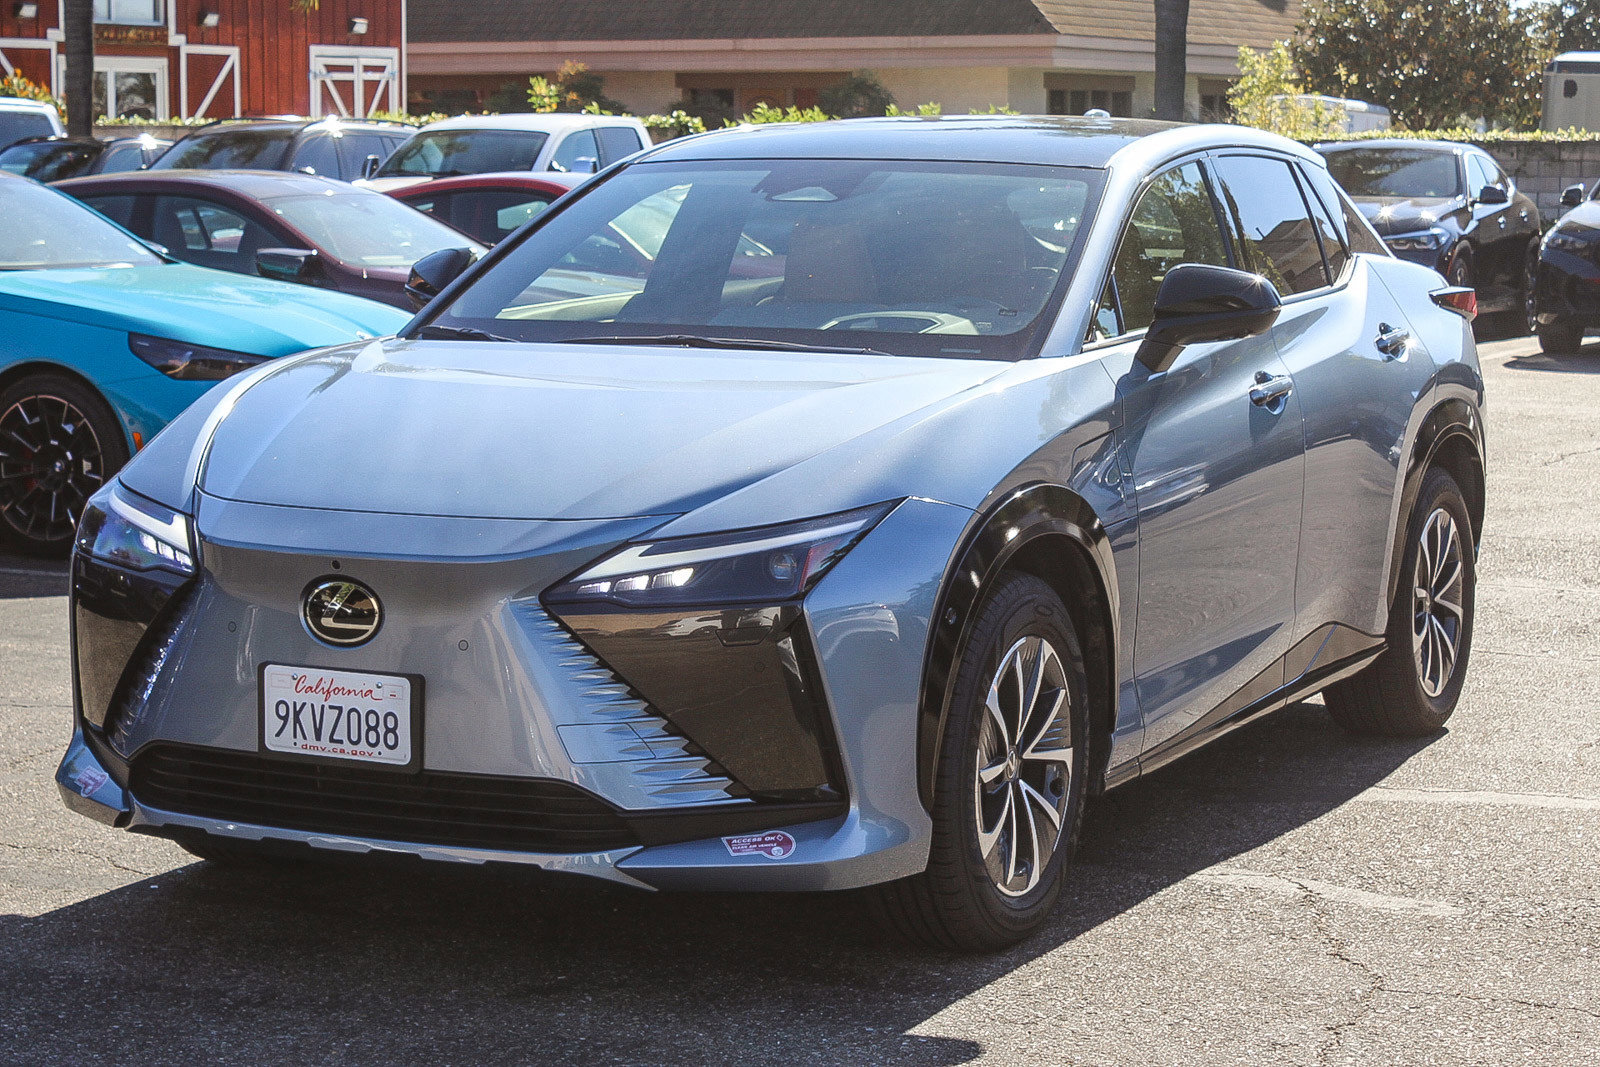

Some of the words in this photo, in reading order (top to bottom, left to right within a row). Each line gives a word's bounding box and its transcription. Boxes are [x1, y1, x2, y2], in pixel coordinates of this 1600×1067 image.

[294, 674, 383, 702] California
[275, 700, 399, 750] 9KVZ088
[301, 743, 374, 757] dmv.ca.gov
